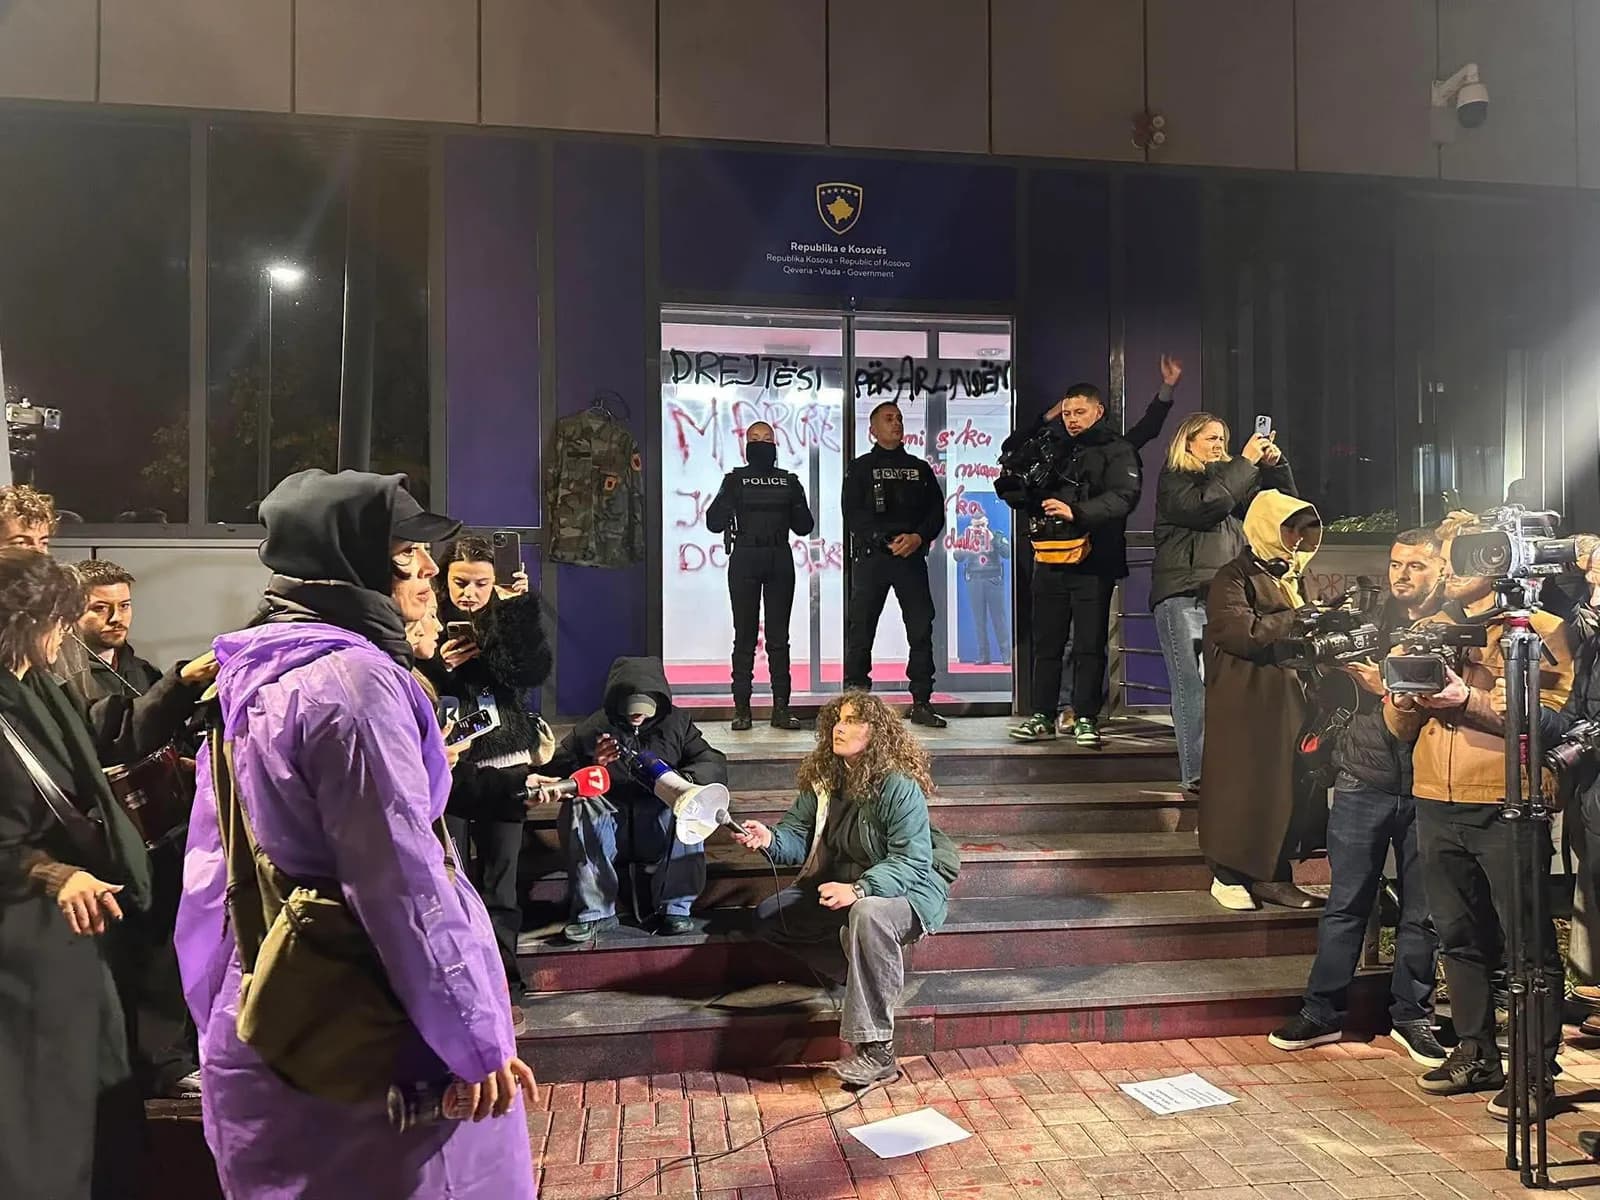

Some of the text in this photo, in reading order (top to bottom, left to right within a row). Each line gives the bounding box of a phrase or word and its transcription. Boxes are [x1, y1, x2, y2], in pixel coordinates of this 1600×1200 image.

[790, 242, 839, 254] Republika
[848, 244, 887, 255] Kosovës
[766, 253, 805, 263] Republika
[806, 255, 833, 265] Kosova
[840, 257, 872, 267] Republic
[874, 258, 882, 266] of
[883, 259, 911, 268] Kosovo
[783, 265, 813, 275] Qeveria
[819, 267, 841, 276] Vlada
[847, 268, 895, 278] Government
[669, 348, 822, 391] DREJTËSI
[742, 477, 788, 486] POLICE
